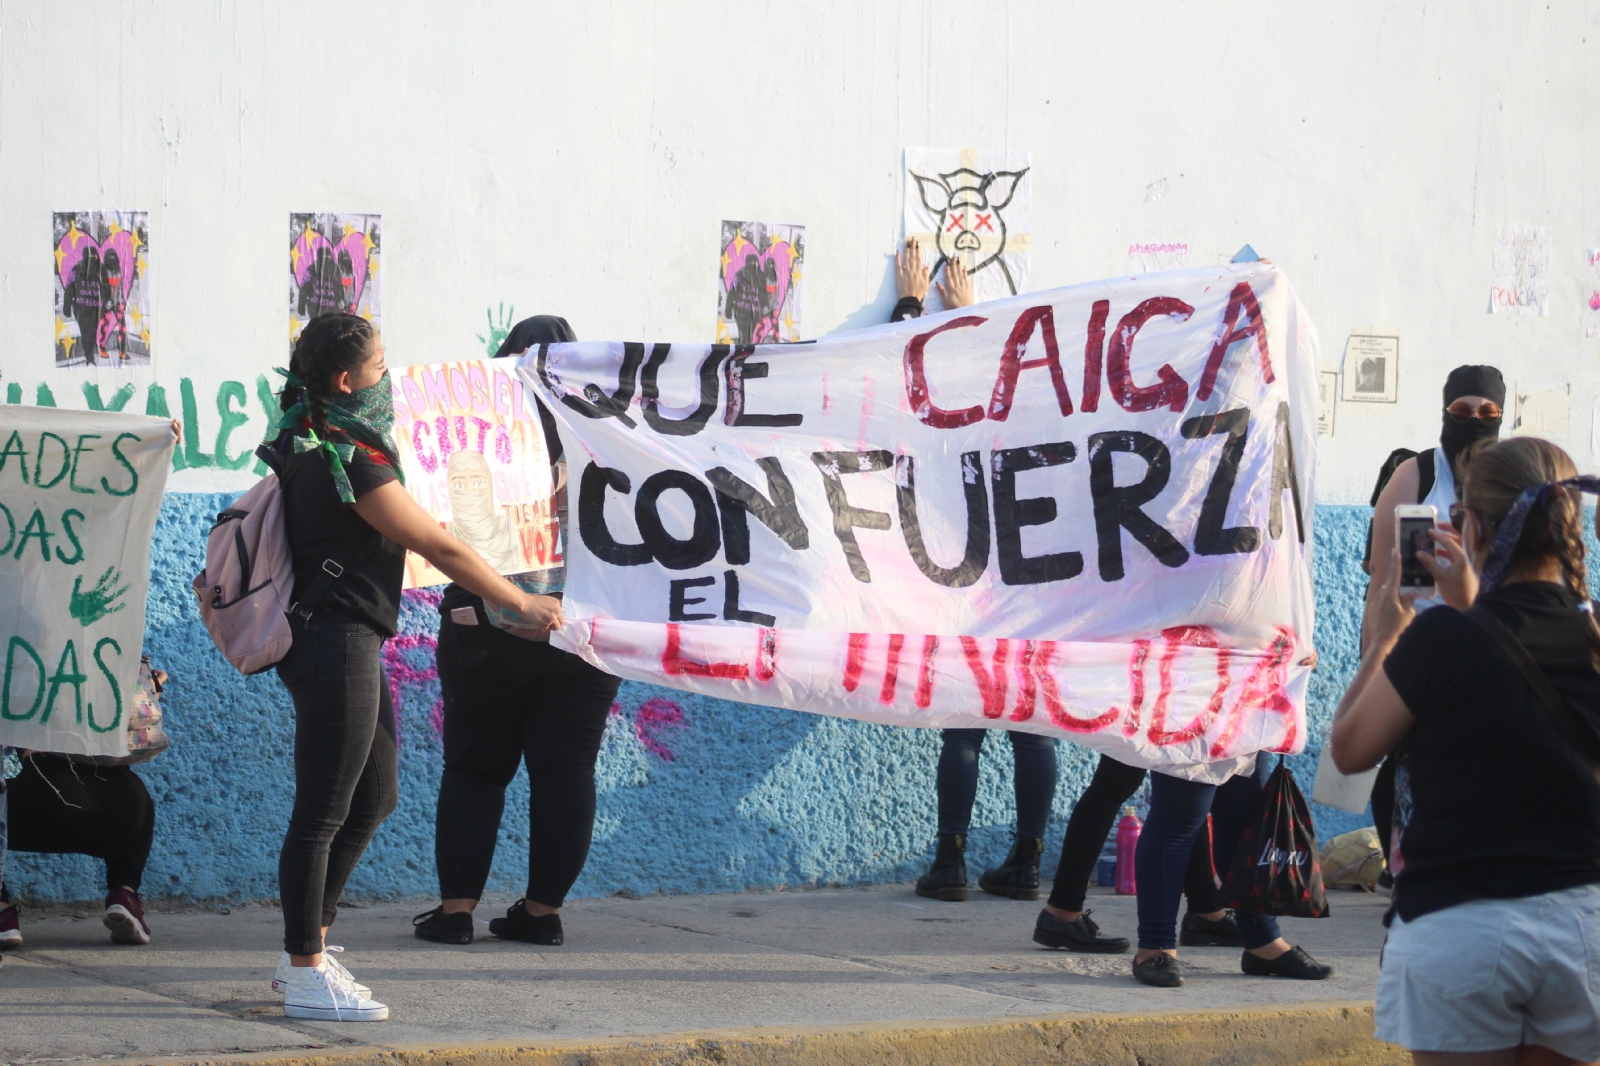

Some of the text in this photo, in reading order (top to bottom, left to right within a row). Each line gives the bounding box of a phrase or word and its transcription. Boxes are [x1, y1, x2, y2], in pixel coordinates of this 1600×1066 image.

[76, 297, 85, 305] NO
[537, 281, 1276, 437] QUE CAIGA
[393, 365, 530, 427] SOMOS EL
[0, 430, 142, 497] ADES
[578, 401, 1306, 588] CON FUERZA
[519, 521, 564, 566] VOZ
[669, 570, 777, 627] EL
